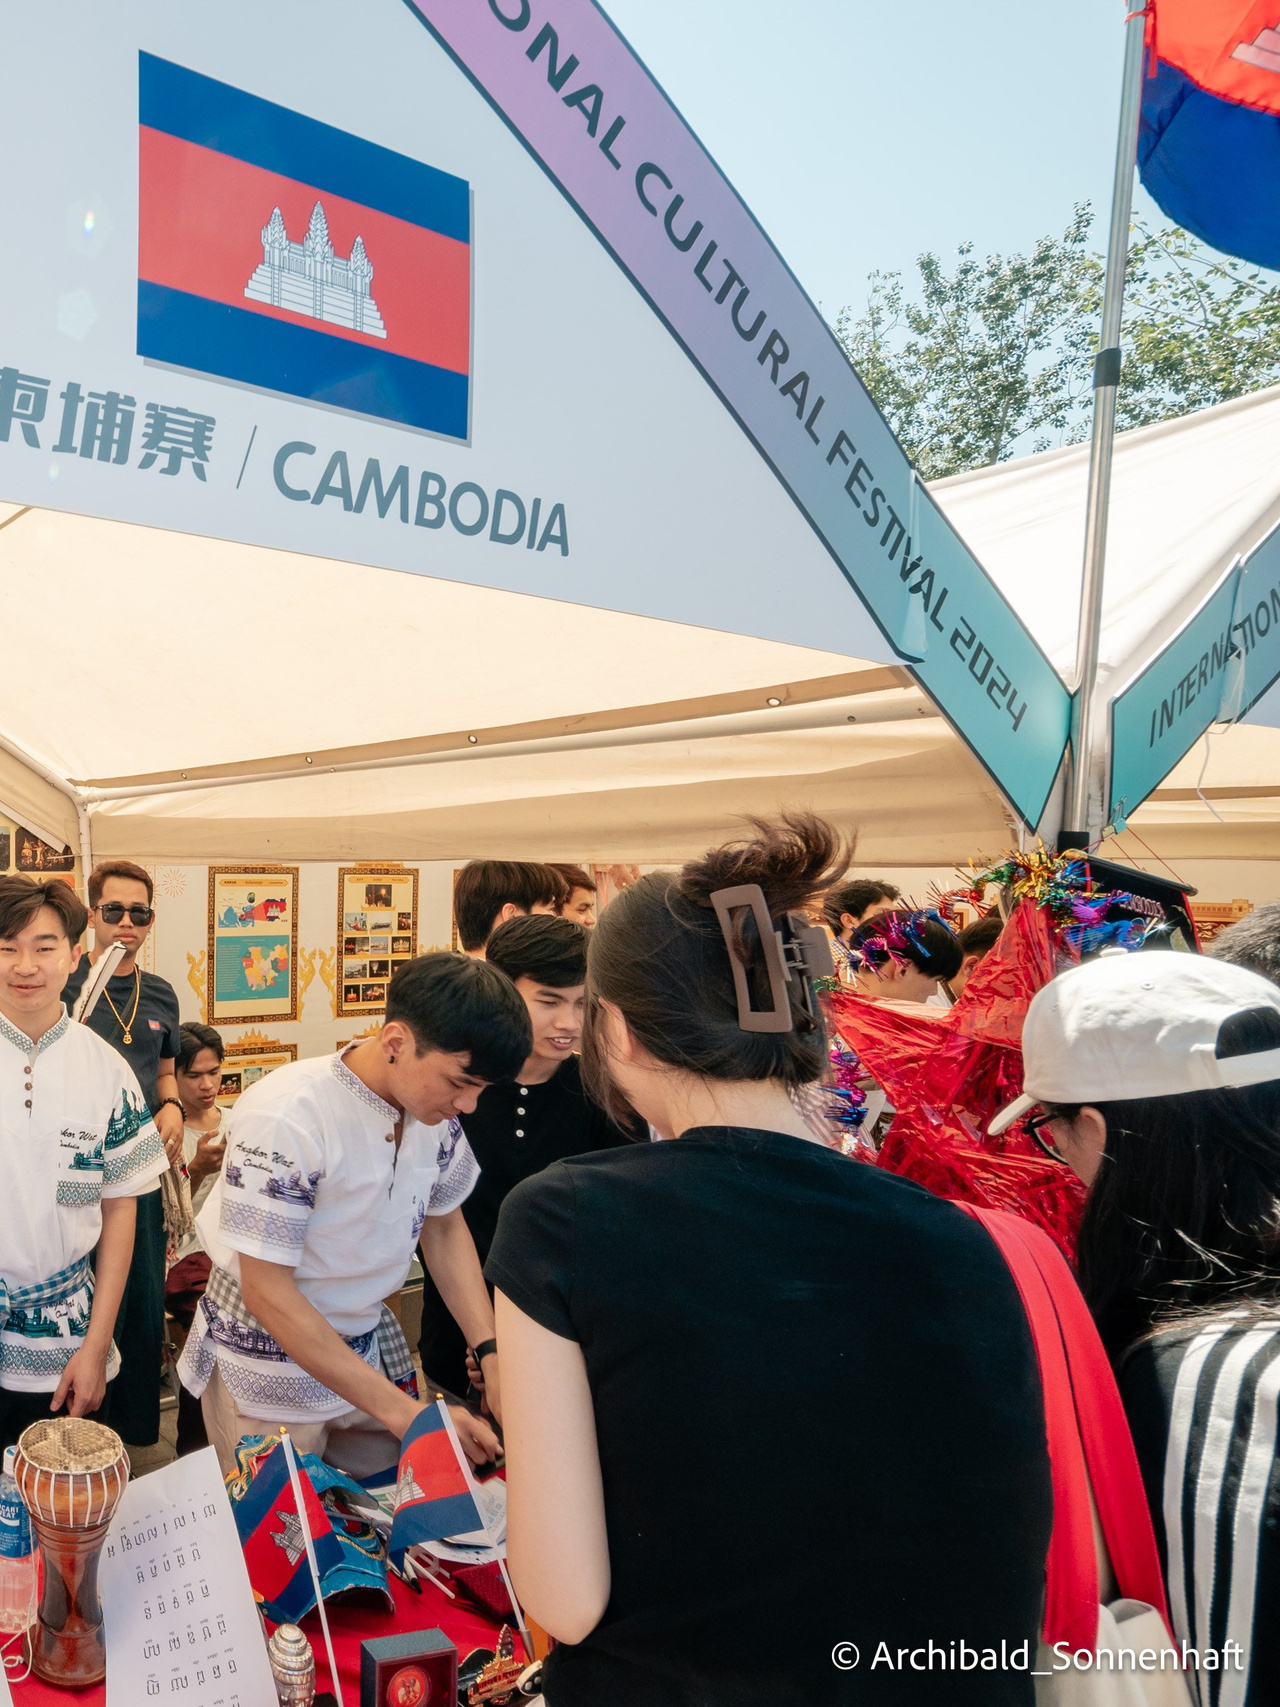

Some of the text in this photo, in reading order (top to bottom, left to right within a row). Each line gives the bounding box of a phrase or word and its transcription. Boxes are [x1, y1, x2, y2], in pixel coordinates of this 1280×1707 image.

[272, 440, 570, 557] CAMBODIA
[635, 161, 829, 446] CULTURAL
[827, 428, 949, 633] FESTIVAL
[950, 615, 1029, 732] 2024
[234, 1141, 295, 1168] Angkor Wat
